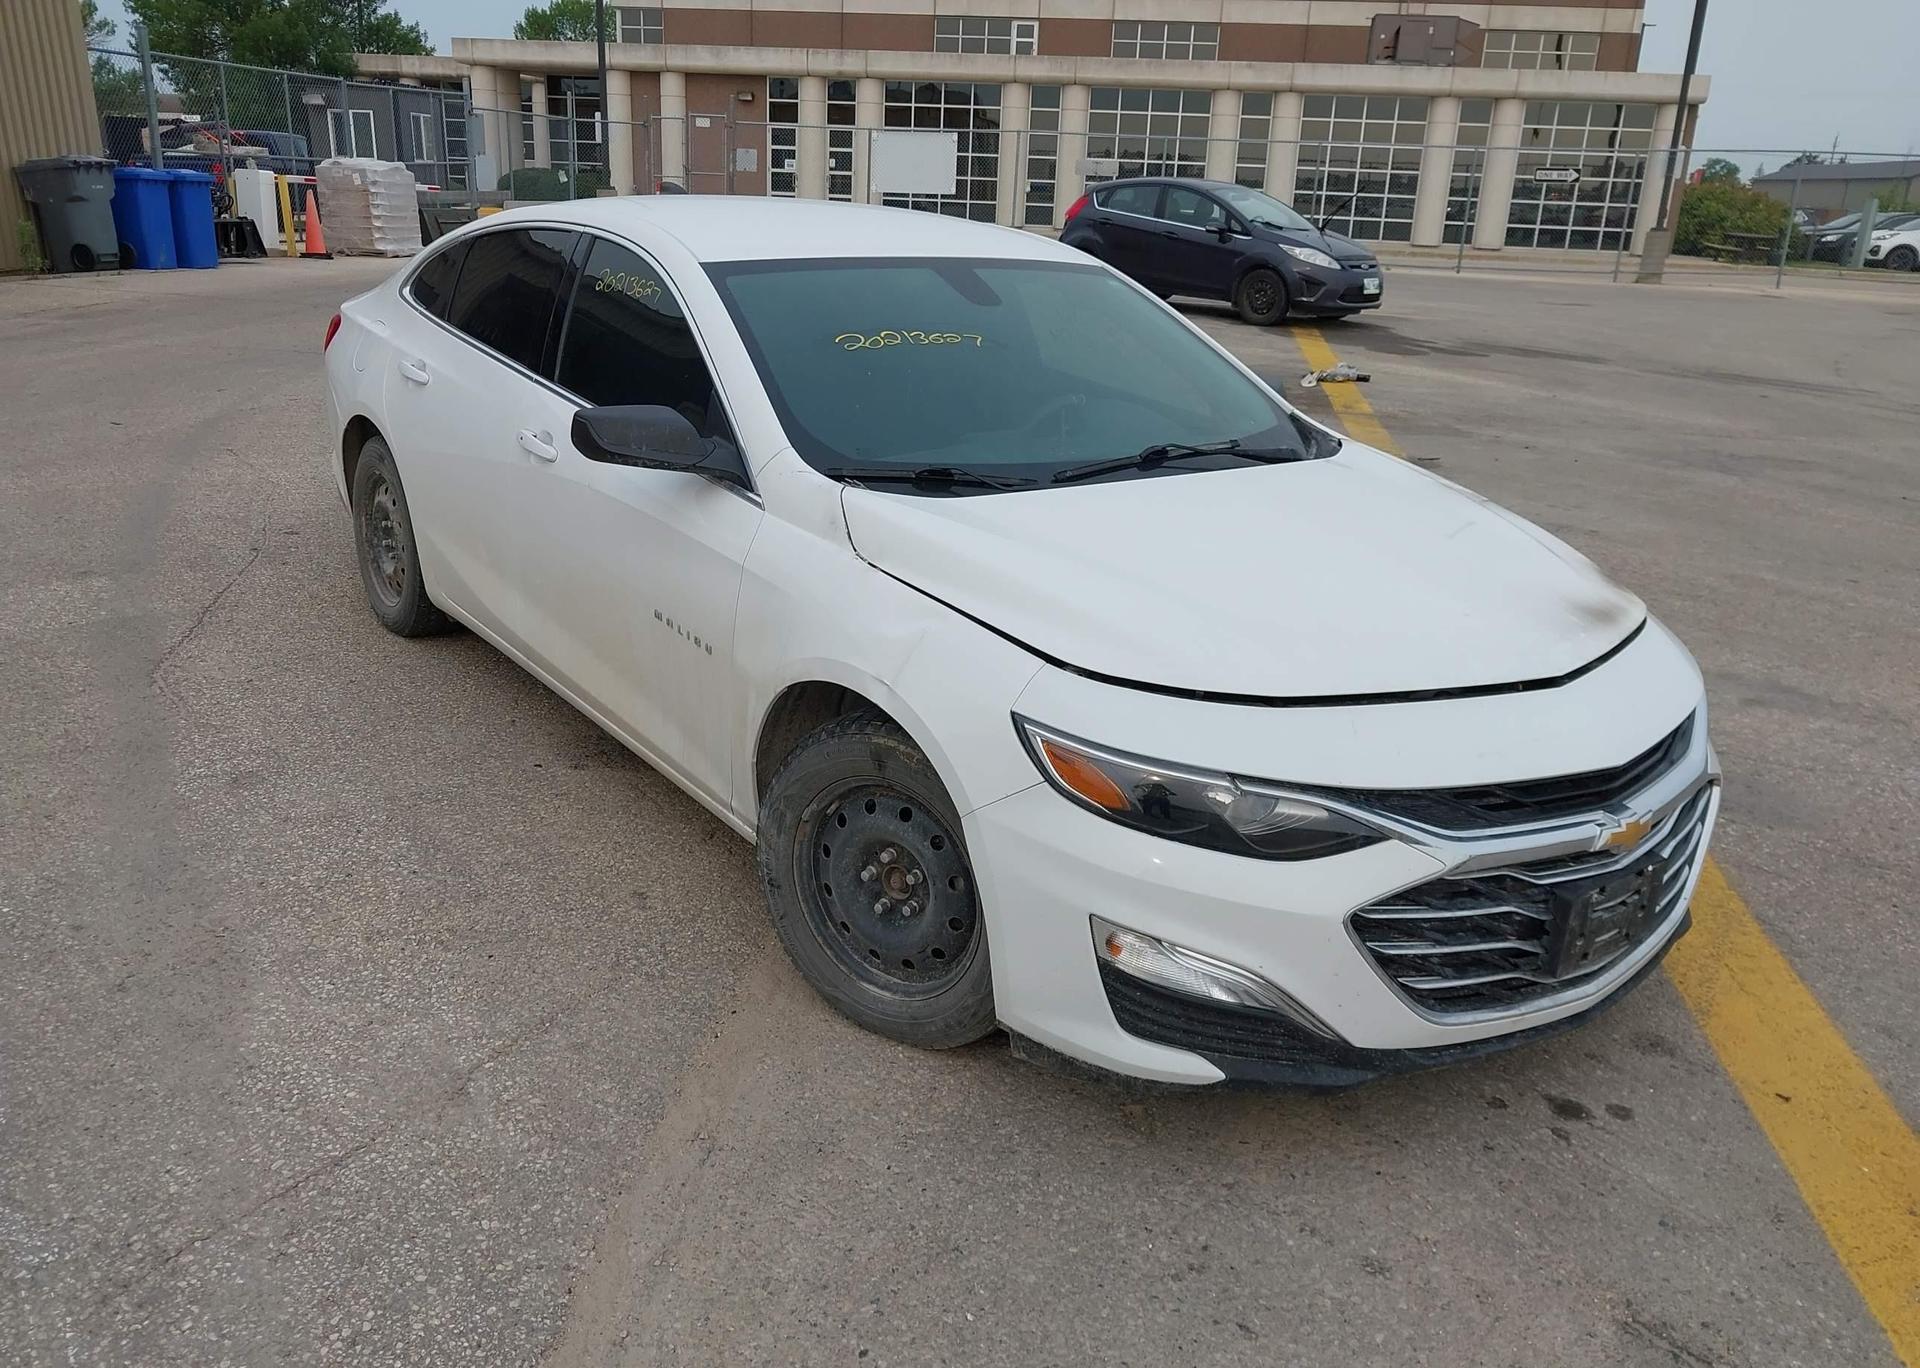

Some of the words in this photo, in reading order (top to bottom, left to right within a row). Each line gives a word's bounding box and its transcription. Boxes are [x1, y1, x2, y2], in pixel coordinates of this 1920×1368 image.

[1538, 171, 1553, 179] ONE
[595, 268, 662, 304] 20213627
[834, 330, 983, 350] 20213627
[654, 608, 712, 655] MALIBU
